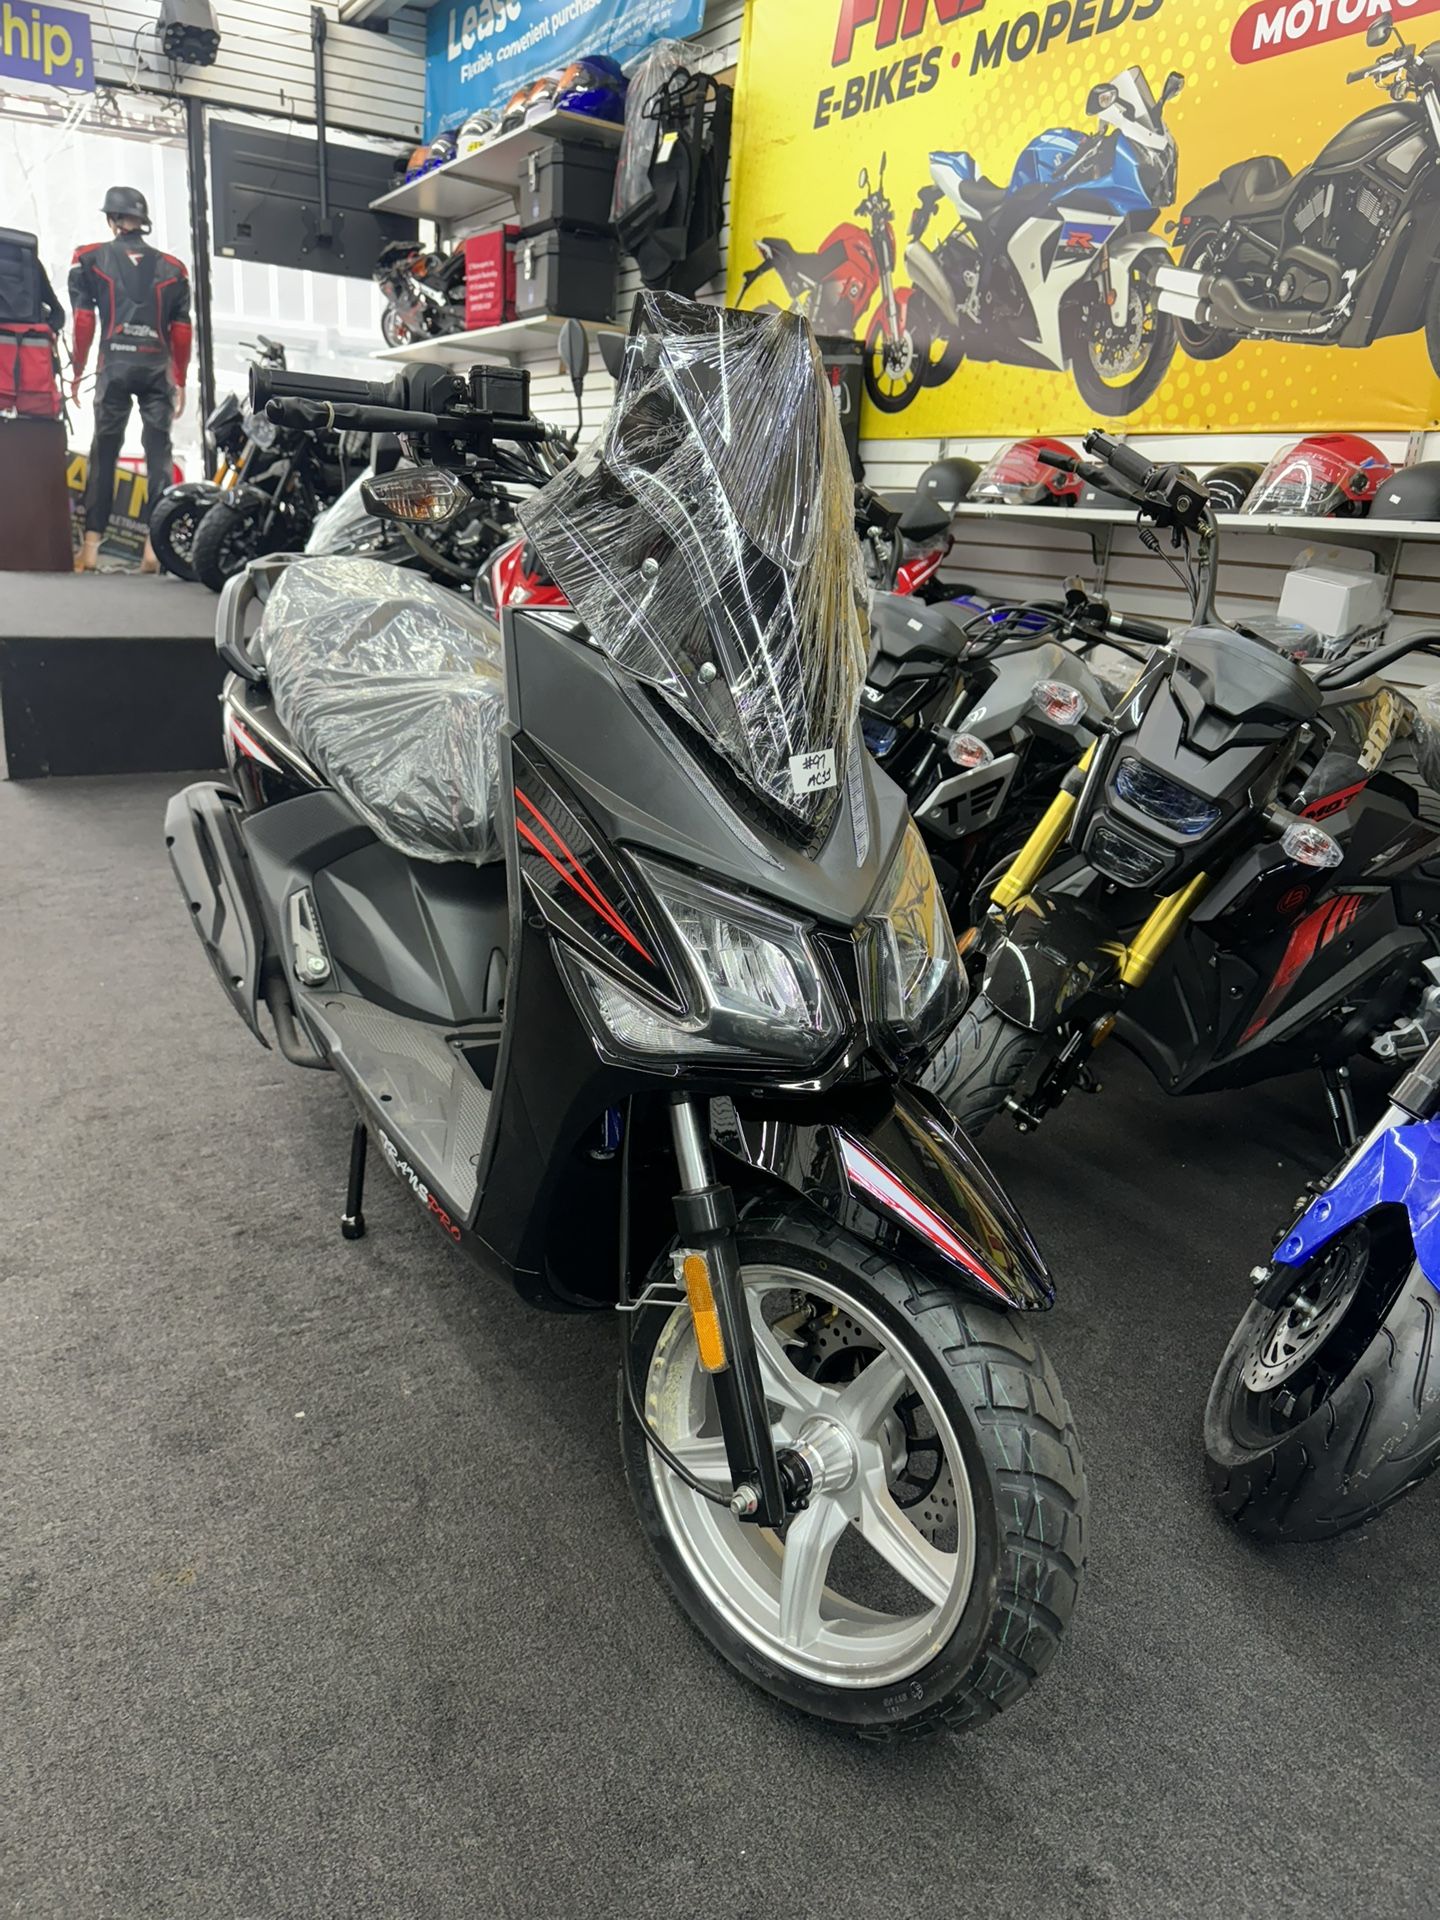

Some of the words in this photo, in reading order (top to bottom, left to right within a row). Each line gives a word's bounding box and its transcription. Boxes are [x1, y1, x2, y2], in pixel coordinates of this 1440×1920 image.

[0, 3, 84, 78] hip,
[496, 16, 550, 62] convenient
[1252, 0, 1420, 50] MOTO
[813, 46, 943, 129] E-BIKES
